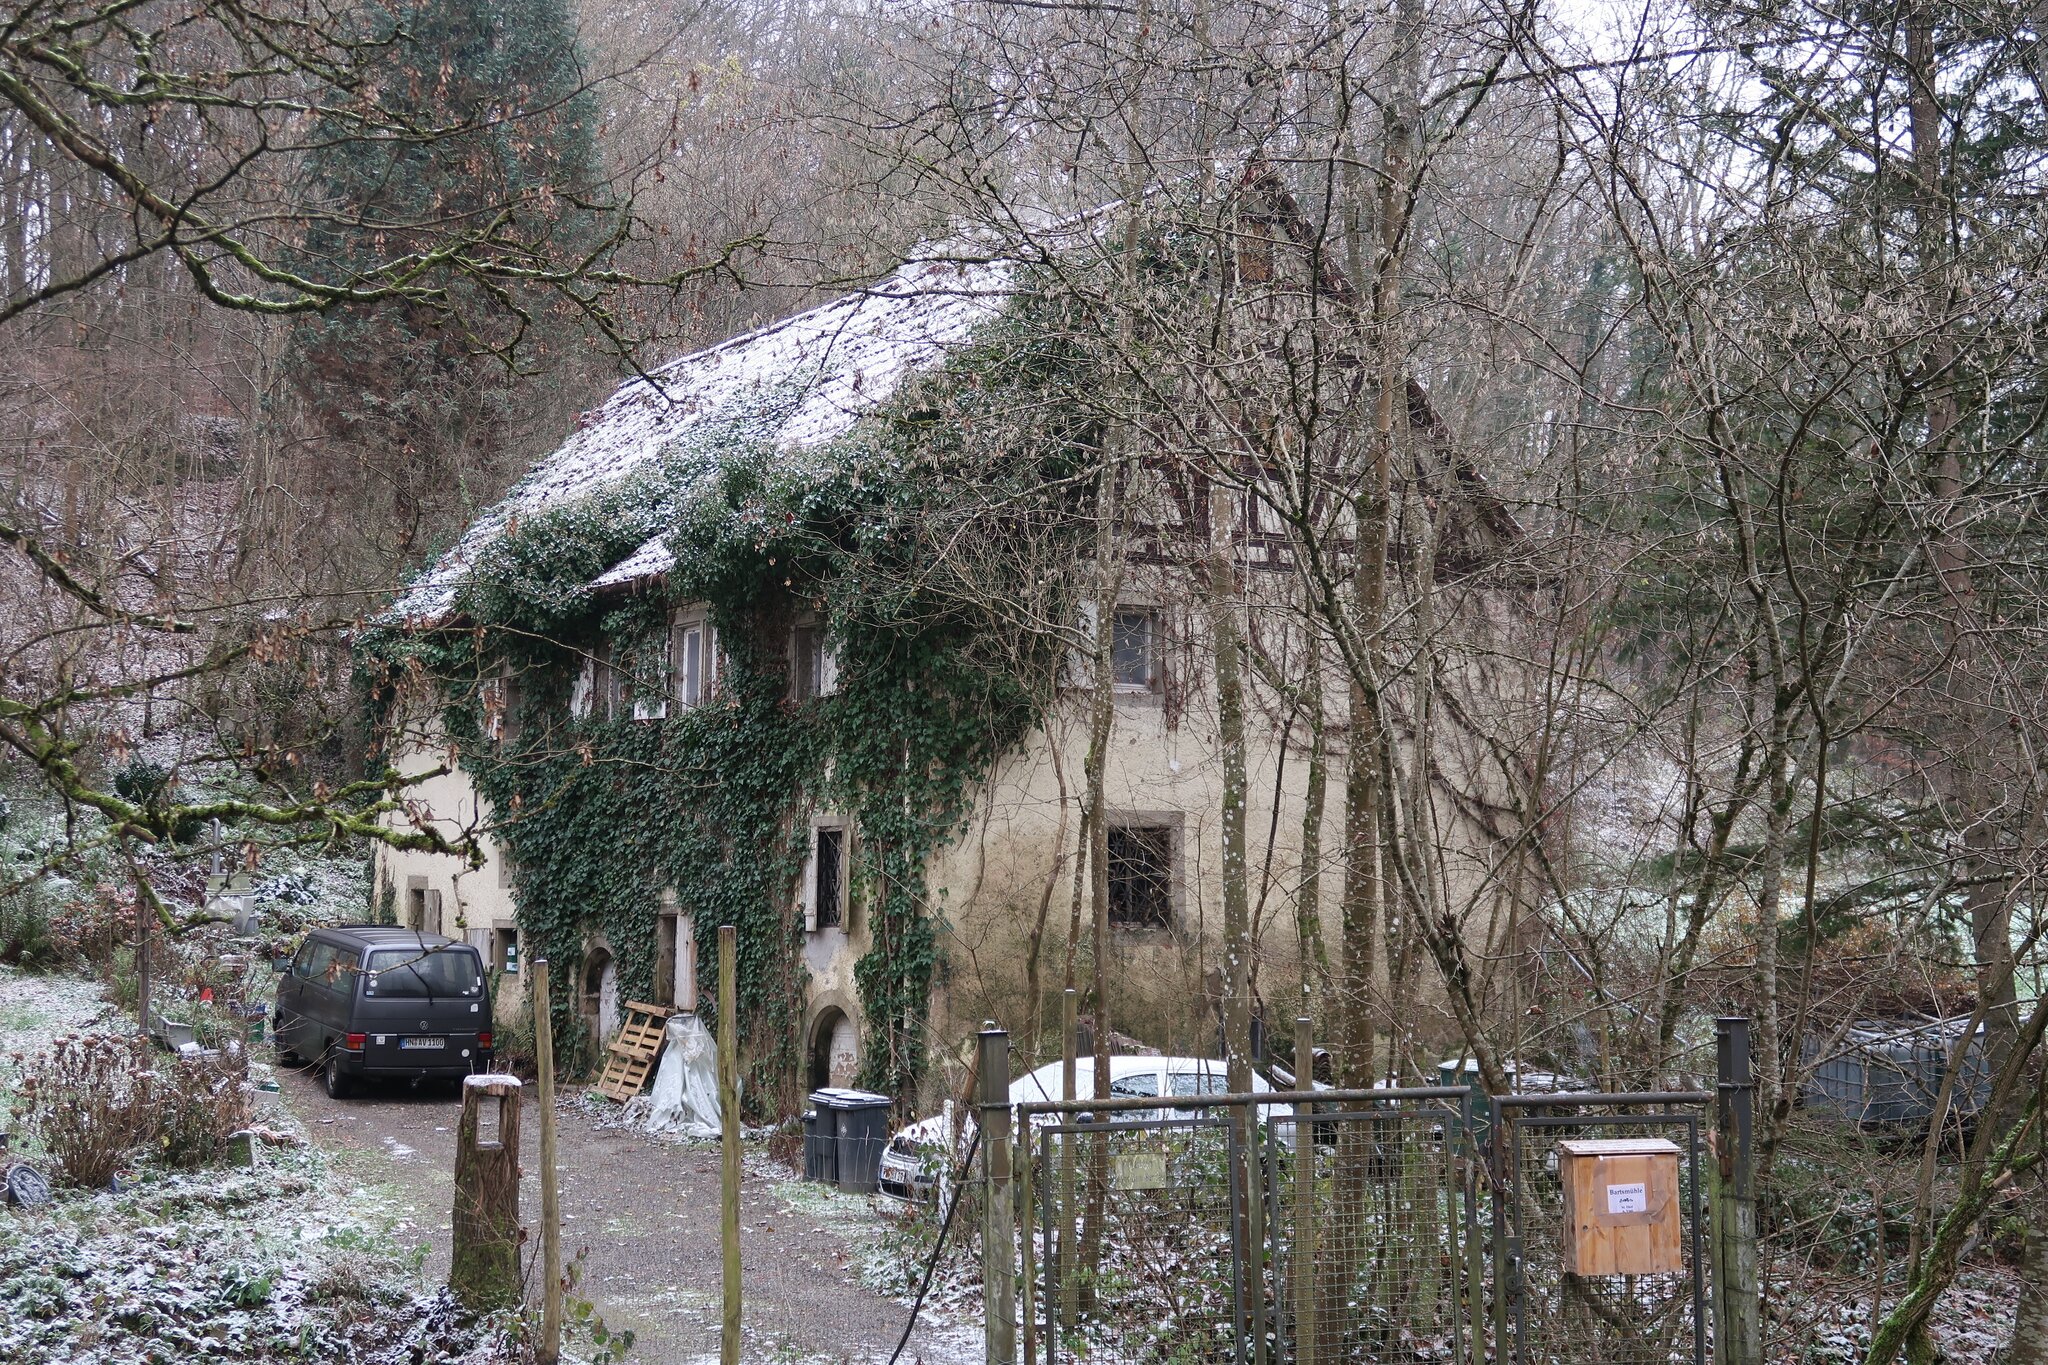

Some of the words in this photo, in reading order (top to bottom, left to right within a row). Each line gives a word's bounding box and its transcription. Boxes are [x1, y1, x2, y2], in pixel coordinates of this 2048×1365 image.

[405, 1038, 414, 1046] HN
[418, 1038, 427, 1046] AV
[428, 1038, 444, 1046] 1100
